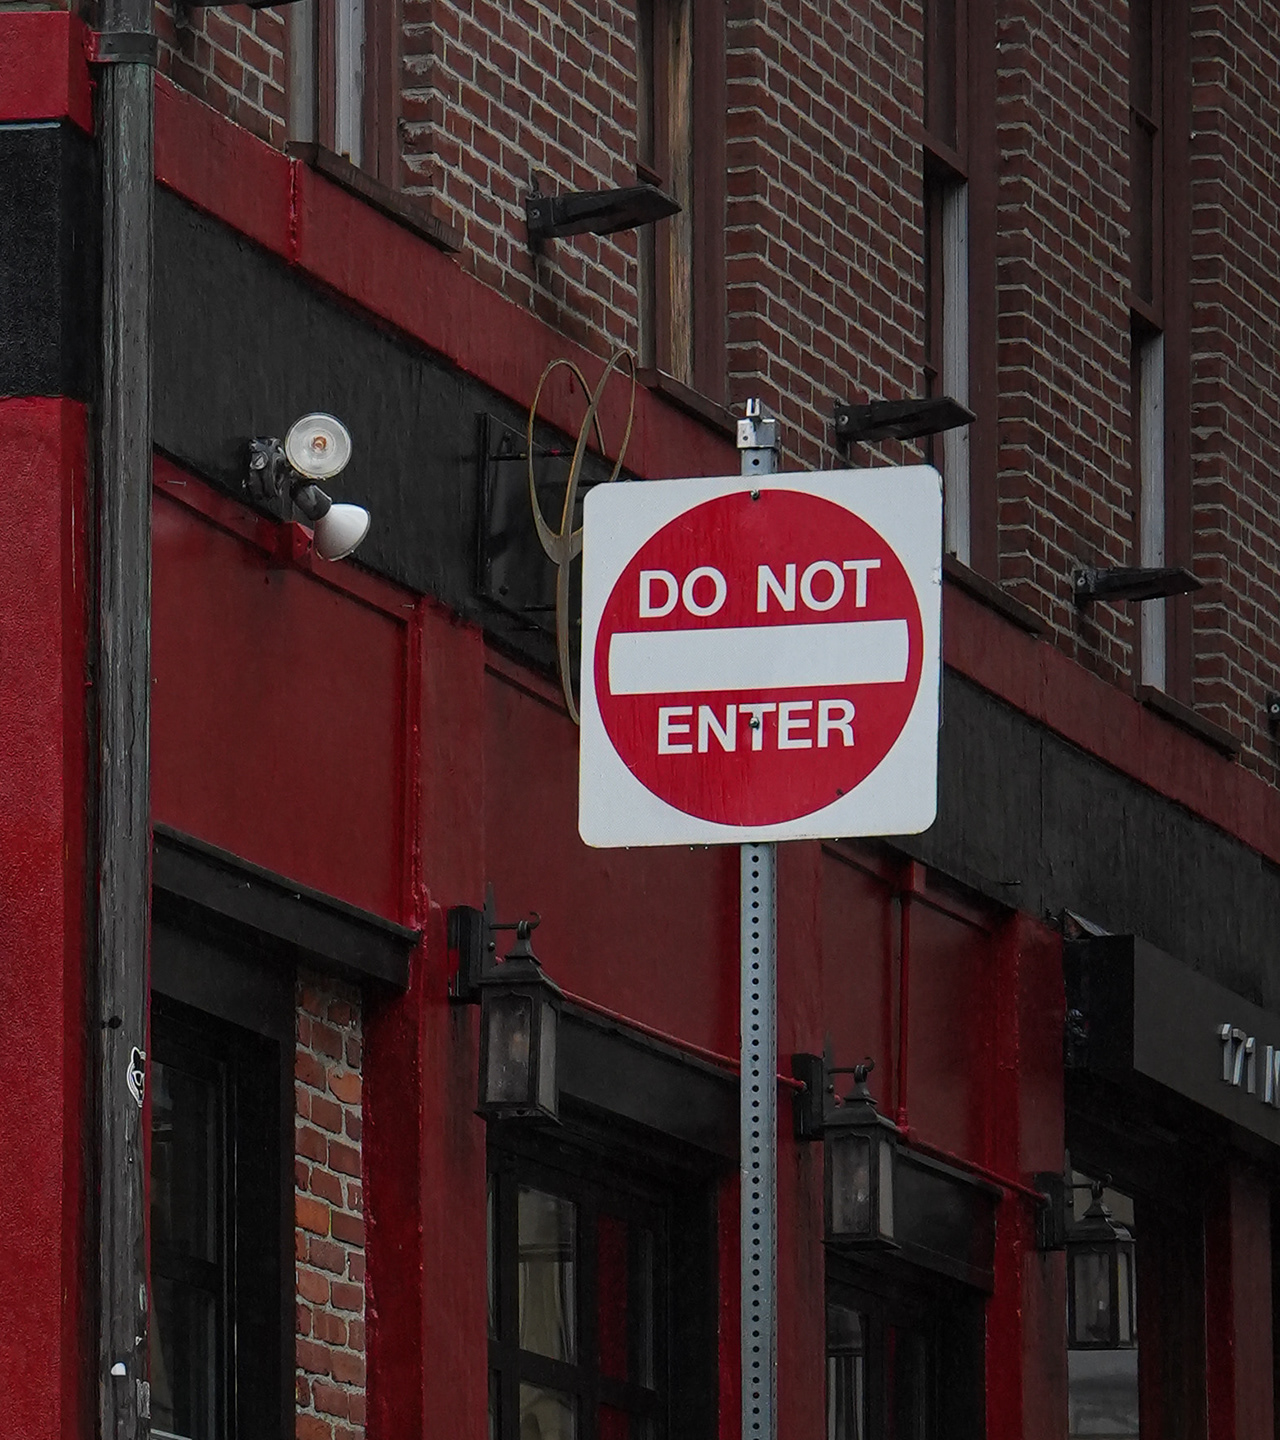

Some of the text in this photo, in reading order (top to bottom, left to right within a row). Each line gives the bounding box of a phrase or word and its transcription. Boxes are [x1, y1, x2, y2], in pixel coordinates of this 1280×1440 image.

[639, 559, 881, 618] DO NOT
[657, 699, 855, 755] ENTER
